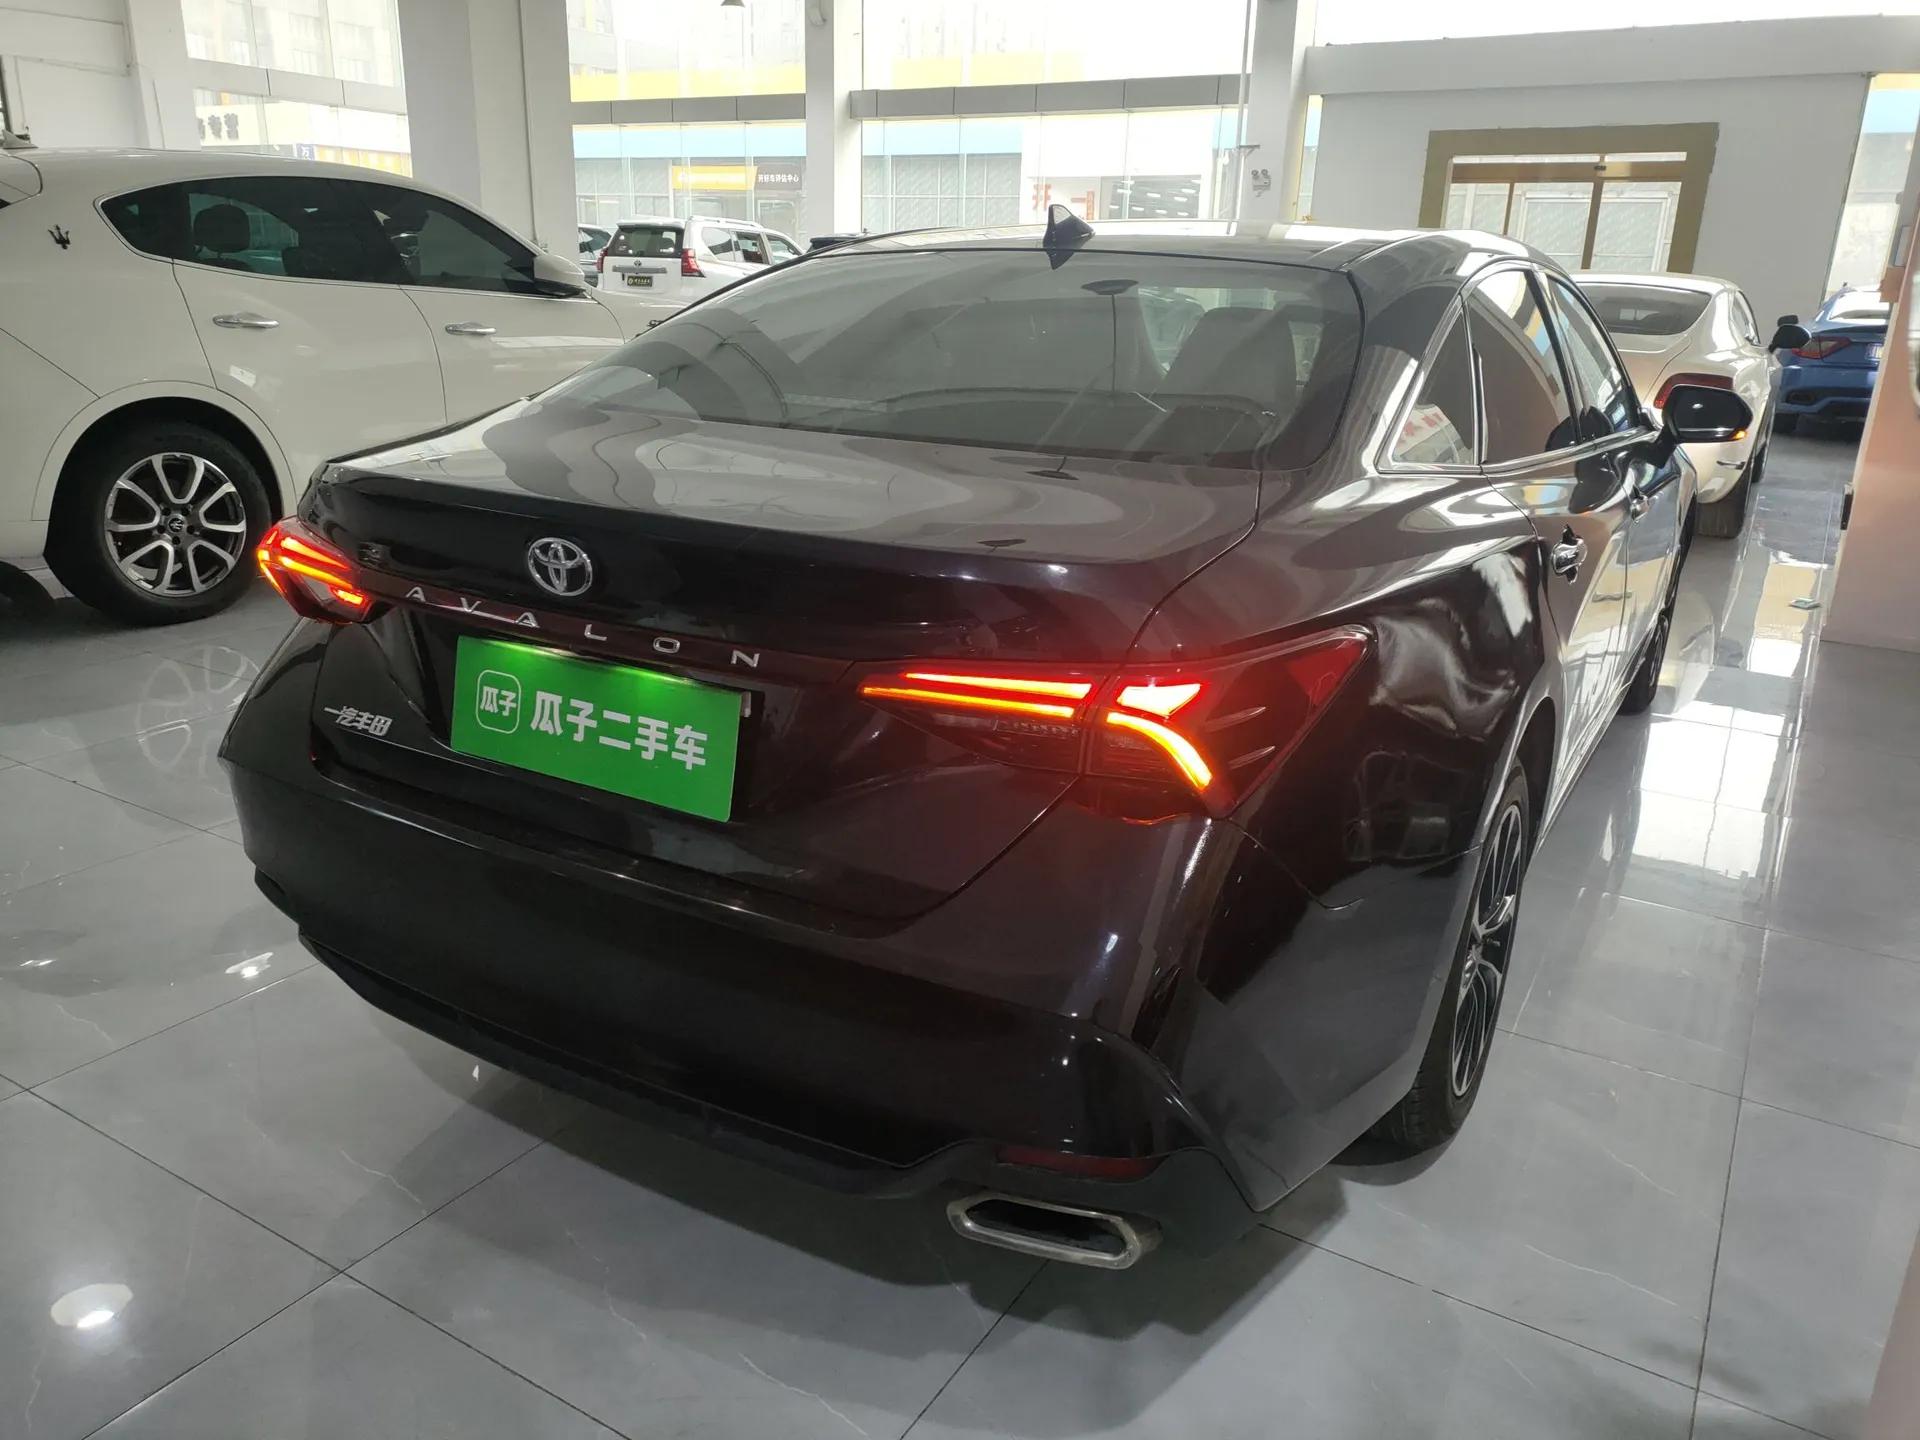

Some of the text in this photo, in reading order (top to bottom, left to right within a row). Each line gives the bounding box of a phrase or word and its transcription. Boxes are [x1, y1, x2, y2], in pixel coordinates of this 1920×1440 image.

[406, 586, 761, 668] AVALON
[480, 686, 517, 716] 瓜子
[530, 690, 708, 771] 瓜子二手车
